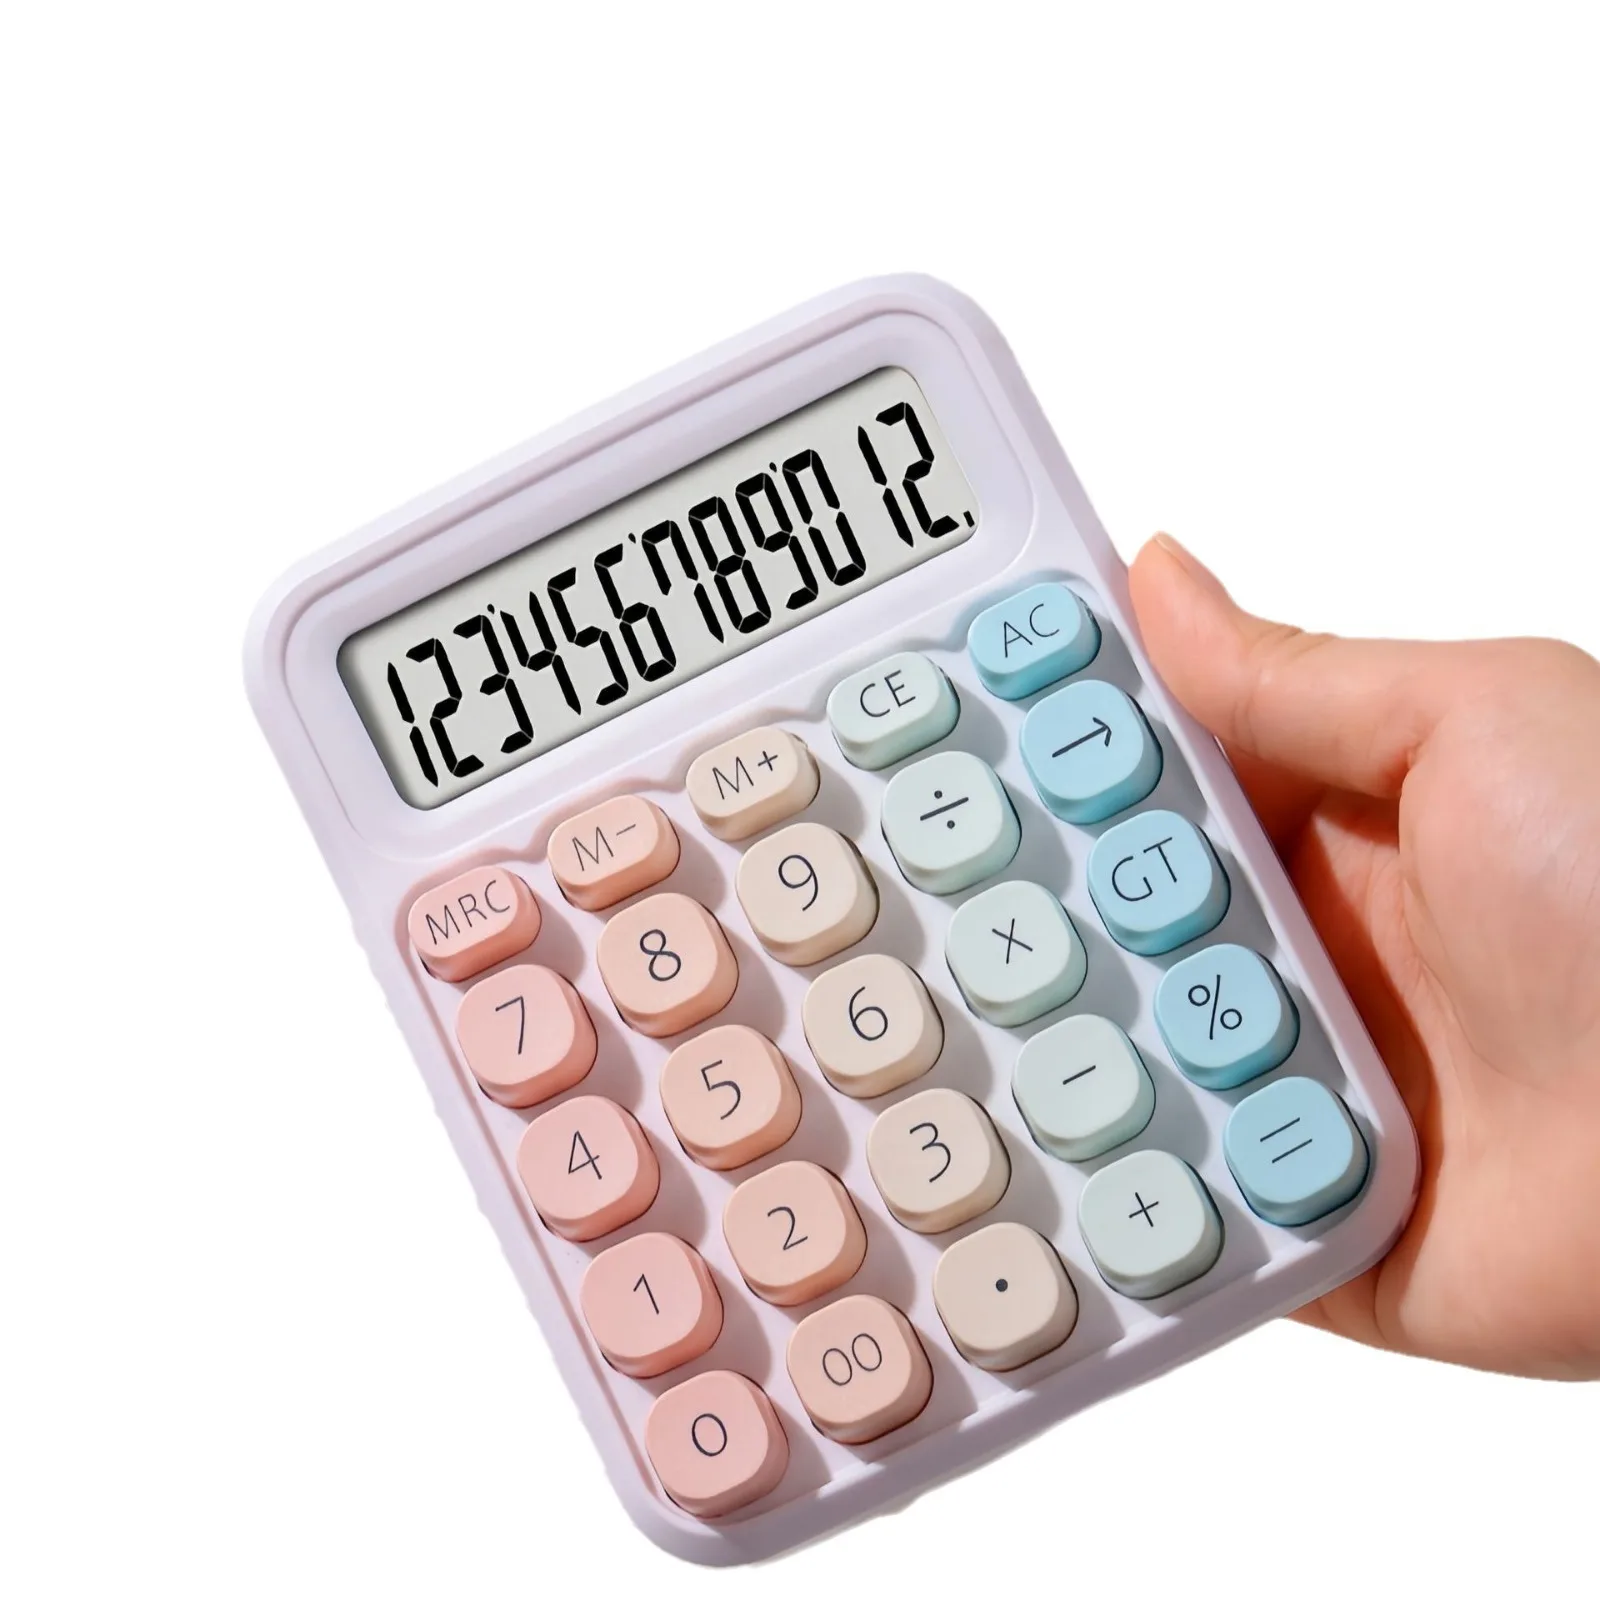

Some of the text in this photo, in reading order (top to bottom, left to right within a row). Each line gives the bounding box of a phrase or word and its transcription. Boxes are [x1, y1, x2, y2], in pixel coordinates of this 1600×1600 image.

[1003, 602, 1064, 661] AC
[860, 670, 921, 722] CE
[708, 745, 784, 804] M+
[778, 855, 818, 911] 9
[1112, 837, 1177, 902] GT
[422, 875, 514, 950] MRC
[640, 929, 681, 982] 8
[495, 996, 525, 1055] 7
[849, 986, 888, 1041] 6
[1188, 974, 1242, 1040] %
[701, 1060, 741, 1120] 5
[568, 1131, 602, 1180] 4
[910, 1122, 951, 1183] 3
[1260, 1117, 1312, 1163] =
[767, 1206, 808, 1251] 2
[1129, 1192, 1159, 1227] +
[633, 1274, 659, 1315] 1
[822, 1333, 882, 1386] 00
[691, 1413, 727, 1457] 0
